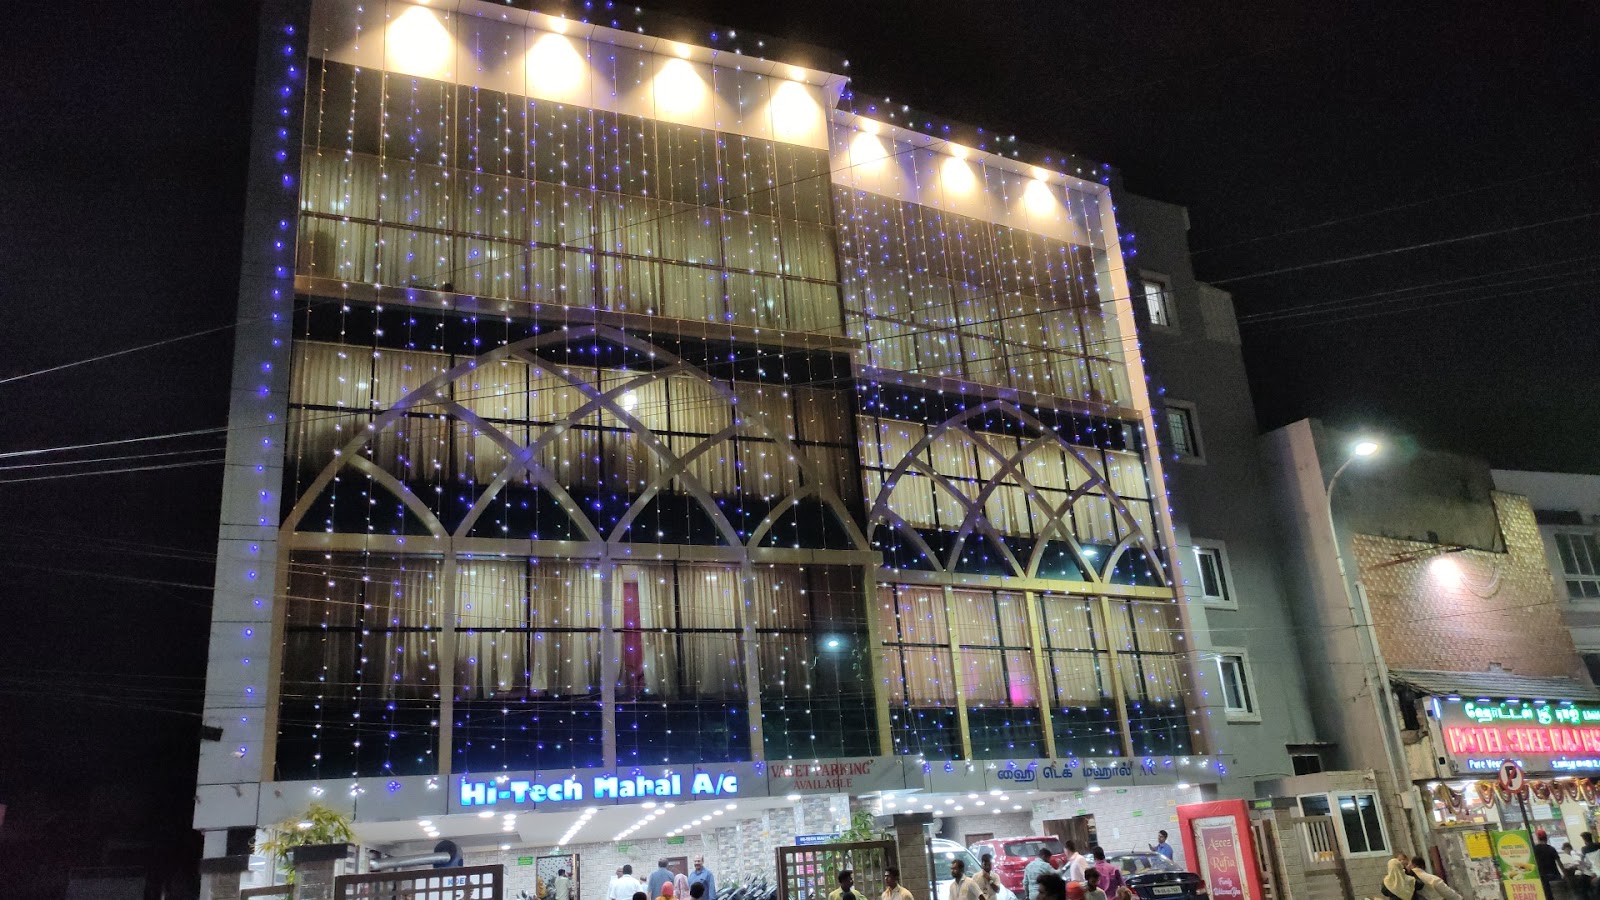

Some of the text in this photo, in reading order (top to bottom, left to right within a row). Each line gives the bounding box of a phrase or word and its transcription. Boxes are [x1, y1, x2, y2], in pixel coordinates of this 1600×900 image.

[1448, 727, 1509, 753] HOTEL
[1507, 727, 1550, 753] SREE
[1549, 727, 1581, 753] RAJ
[815, 762, 870, 777] PARKING
[1468, 759, 1485, 769] Pure
[1505, 766, 1517, 787] P
[461, 779, 583, 807] Hi-Tech
[593, 774, 681, 798] Mahal
[793, 779, 853, 790] AVAILABLE
[1511, 883, 1537, 892] TIFFIN
